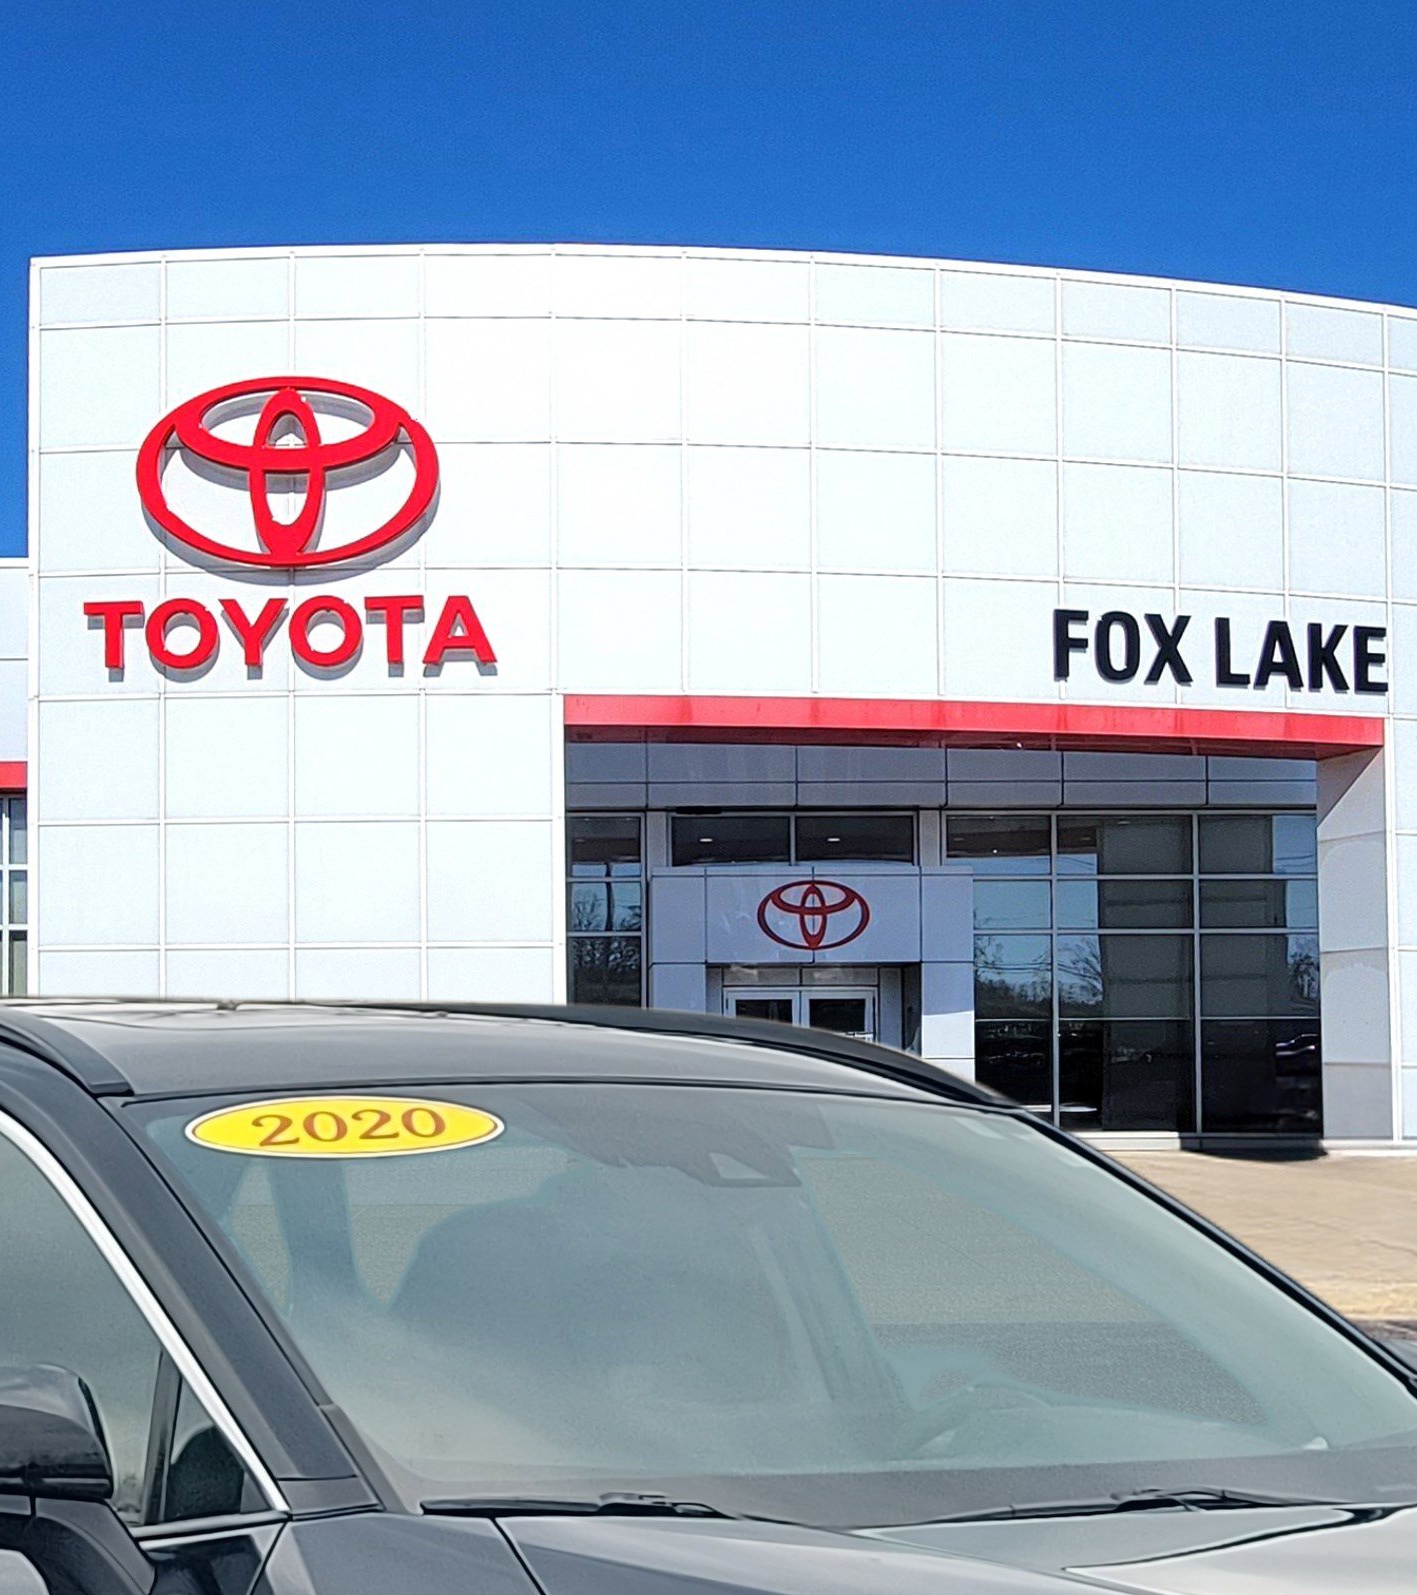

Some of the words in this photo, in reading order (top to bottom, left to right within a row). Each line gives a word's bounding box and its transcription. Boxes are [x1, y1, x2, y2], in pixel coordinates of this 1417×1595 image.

[83, 595, 498, 672] TOYOTA
[1053, 608, 1193, 686] FOX
[1214, 617, 1389, 694] LAKE
[251, 1106, 445, 1147] 2020
